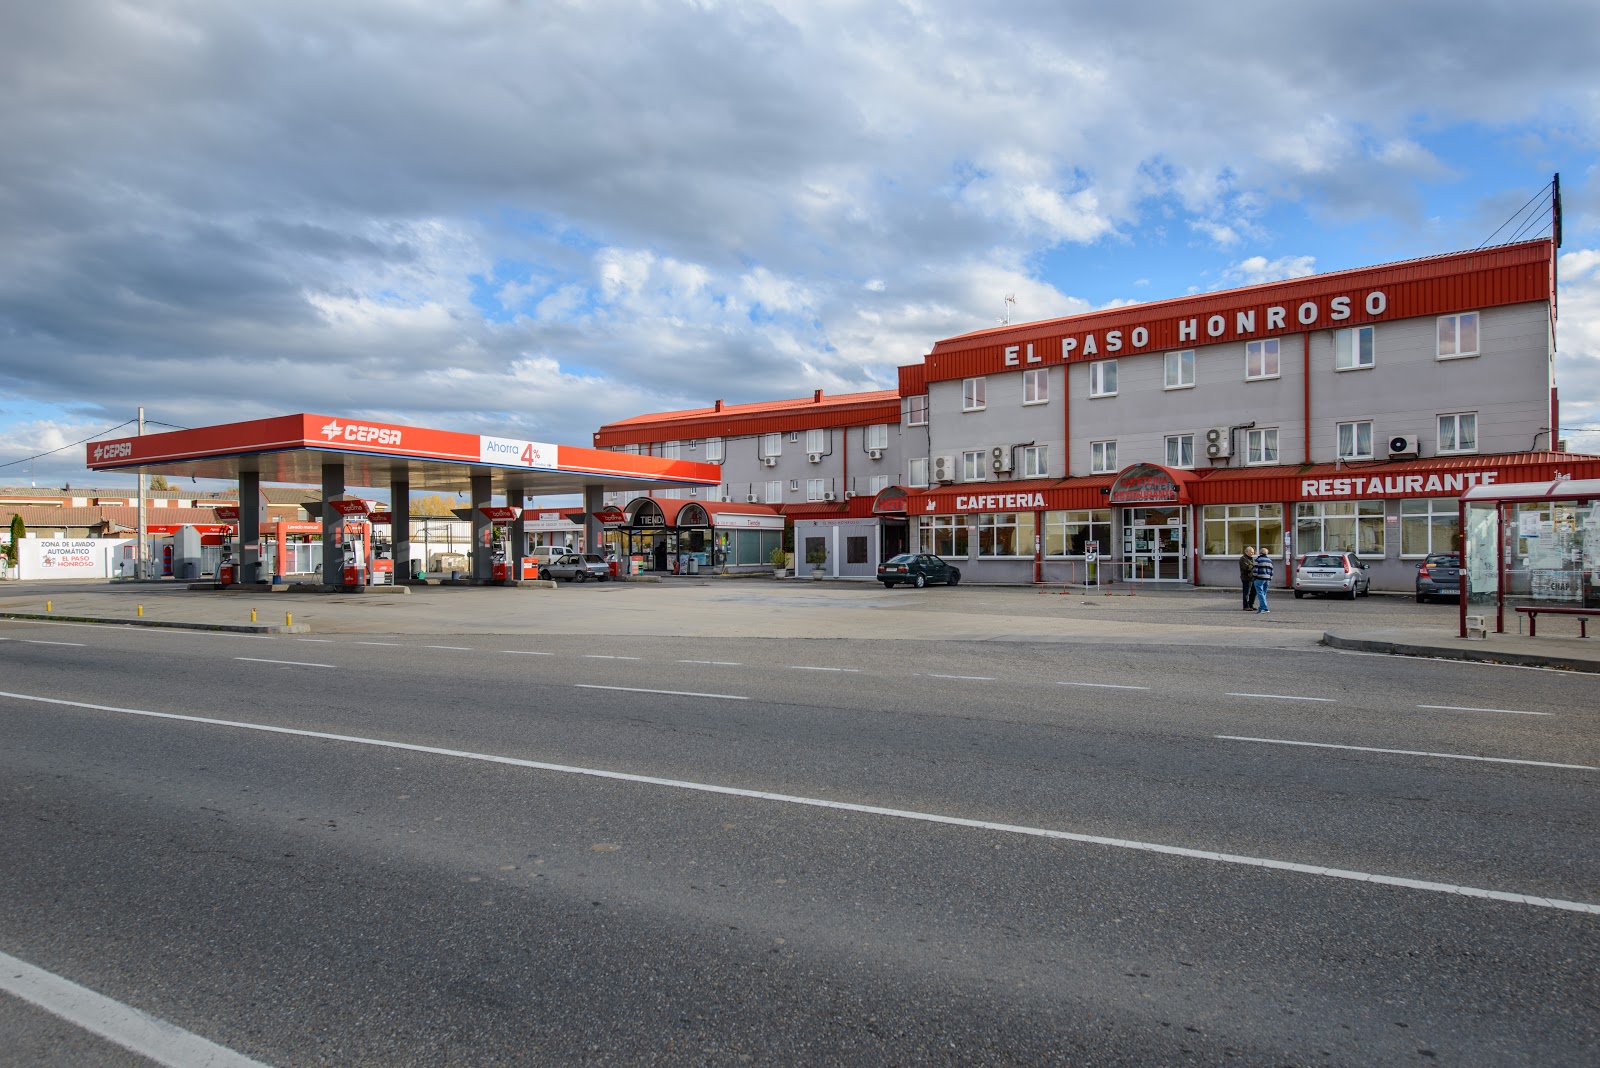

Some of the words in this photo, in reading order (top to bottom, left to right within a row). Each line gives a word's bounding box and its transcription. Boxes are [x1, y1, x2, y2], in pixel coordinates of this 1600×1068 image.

[1004, 344, 1042, 367] EL
[1062, 326, 1149, 359] PASO
[1179, 291, 1388, 342] HONROSO
[344, 424, 402, 446] CEPSA
[104, 442, 132, 459] CEPSA
[487, 440, 519, 455] Ahorra
[1302, 471, 1498, 497] RESTAURANTE
